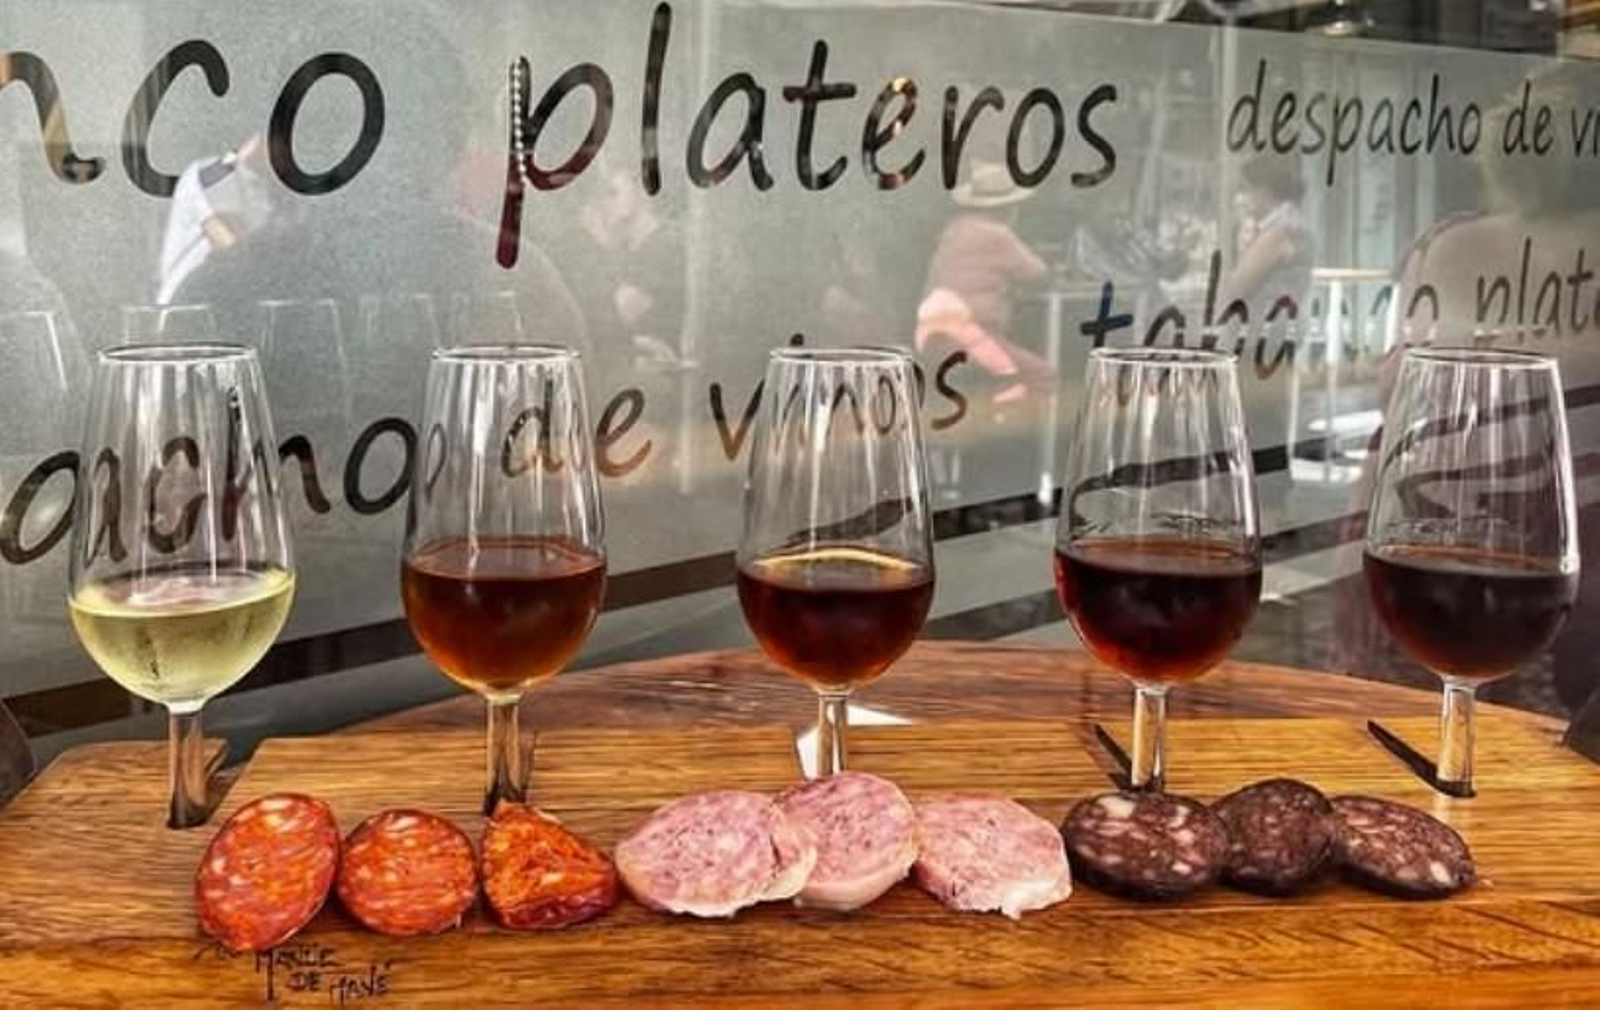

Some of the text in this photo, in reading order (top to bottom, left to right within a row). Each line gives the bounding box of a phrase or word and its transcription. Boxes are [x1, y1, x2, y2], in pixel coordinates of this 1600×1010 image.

[495, 2, 1118, 269] plateros
[1226, 59, 1481, 186] despacho
[1502, 79, 1553, 156] de
[1474, 235, 1600, 350] plat
